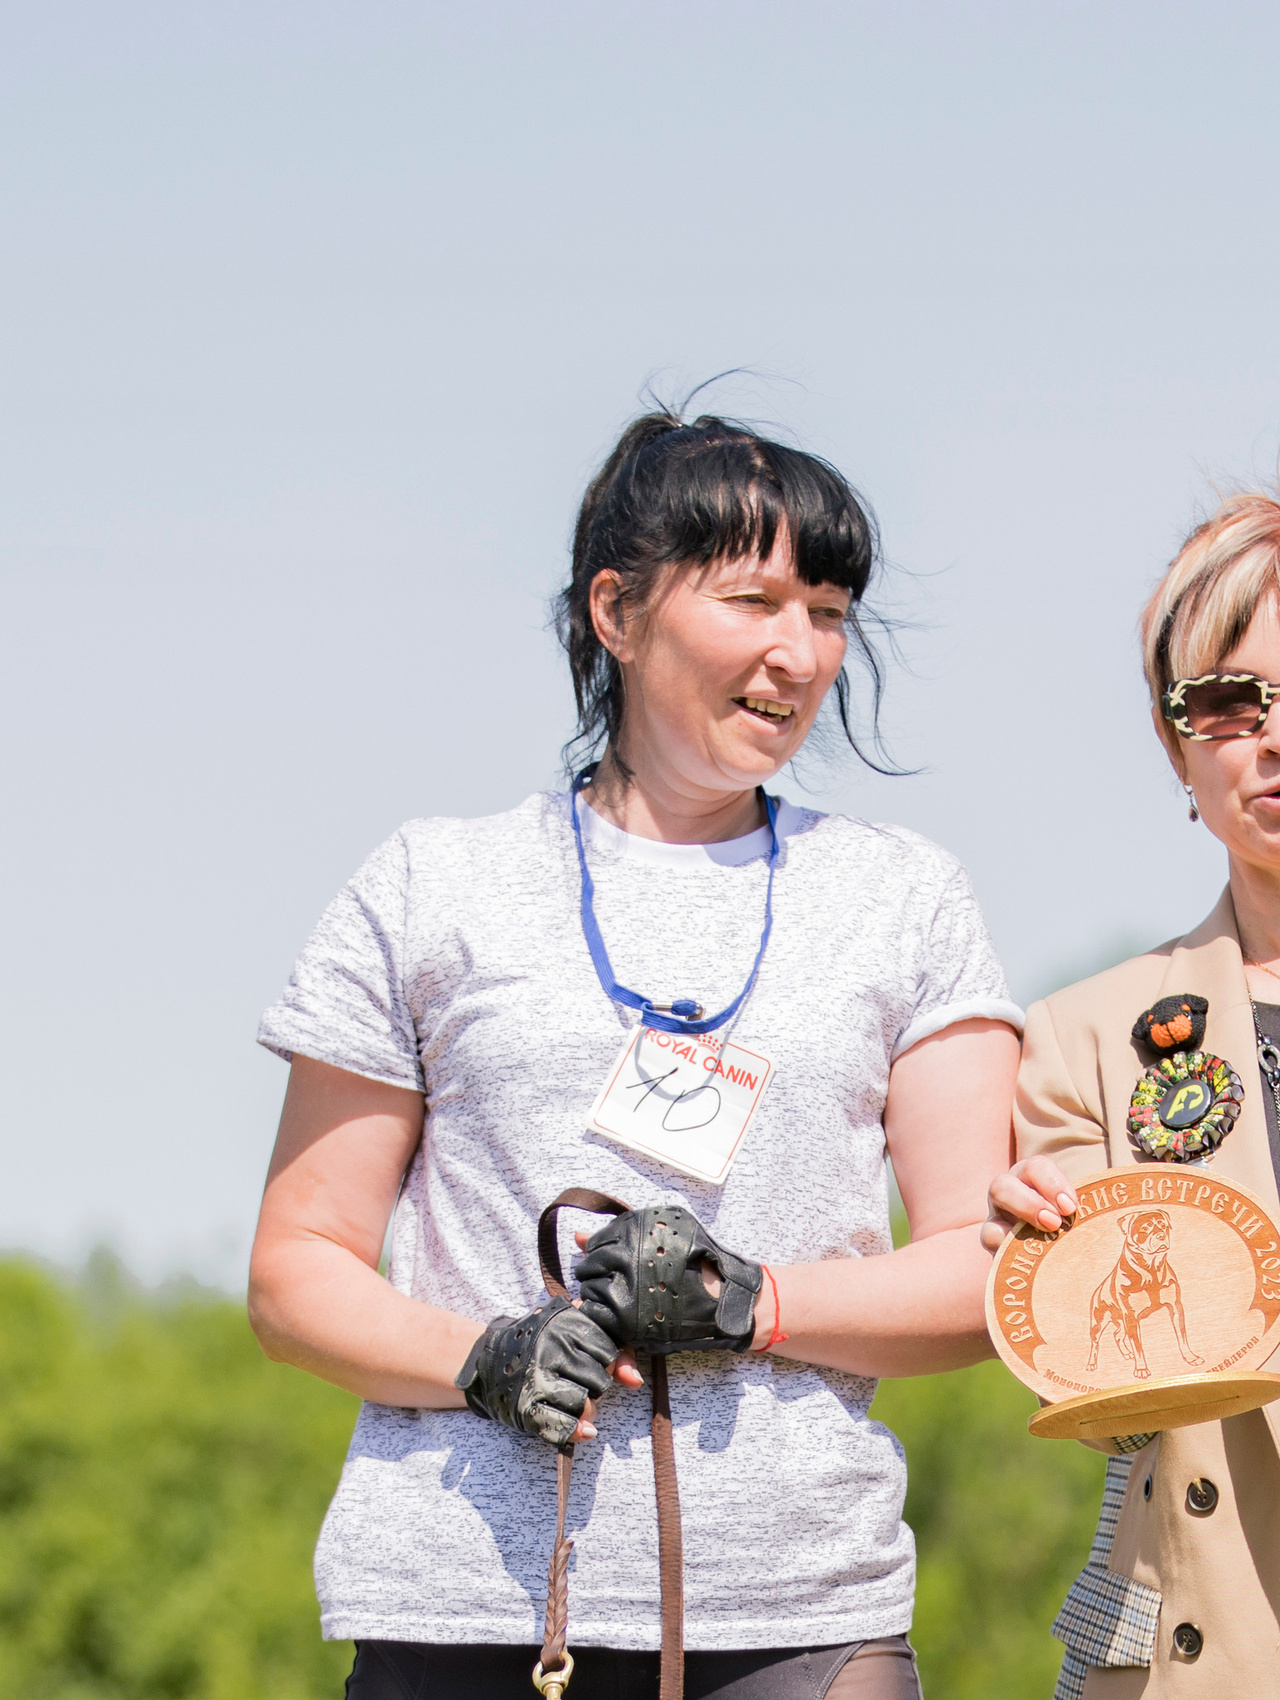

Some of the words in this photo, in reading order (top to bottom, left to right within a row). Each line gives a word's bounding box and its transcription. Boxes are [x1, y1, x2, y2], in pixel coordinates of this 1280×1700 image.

[644, 1027, 698, 1065] ROYAL
[703, 1056, 759, 1091] CANIN
[625, 1066, 722, 1132] 10
[1002, 1182, 1130, 1344] ВОРОНЕКИЕ
[1139, 1177, 1265, 1240] ВСТРЕЧИ
